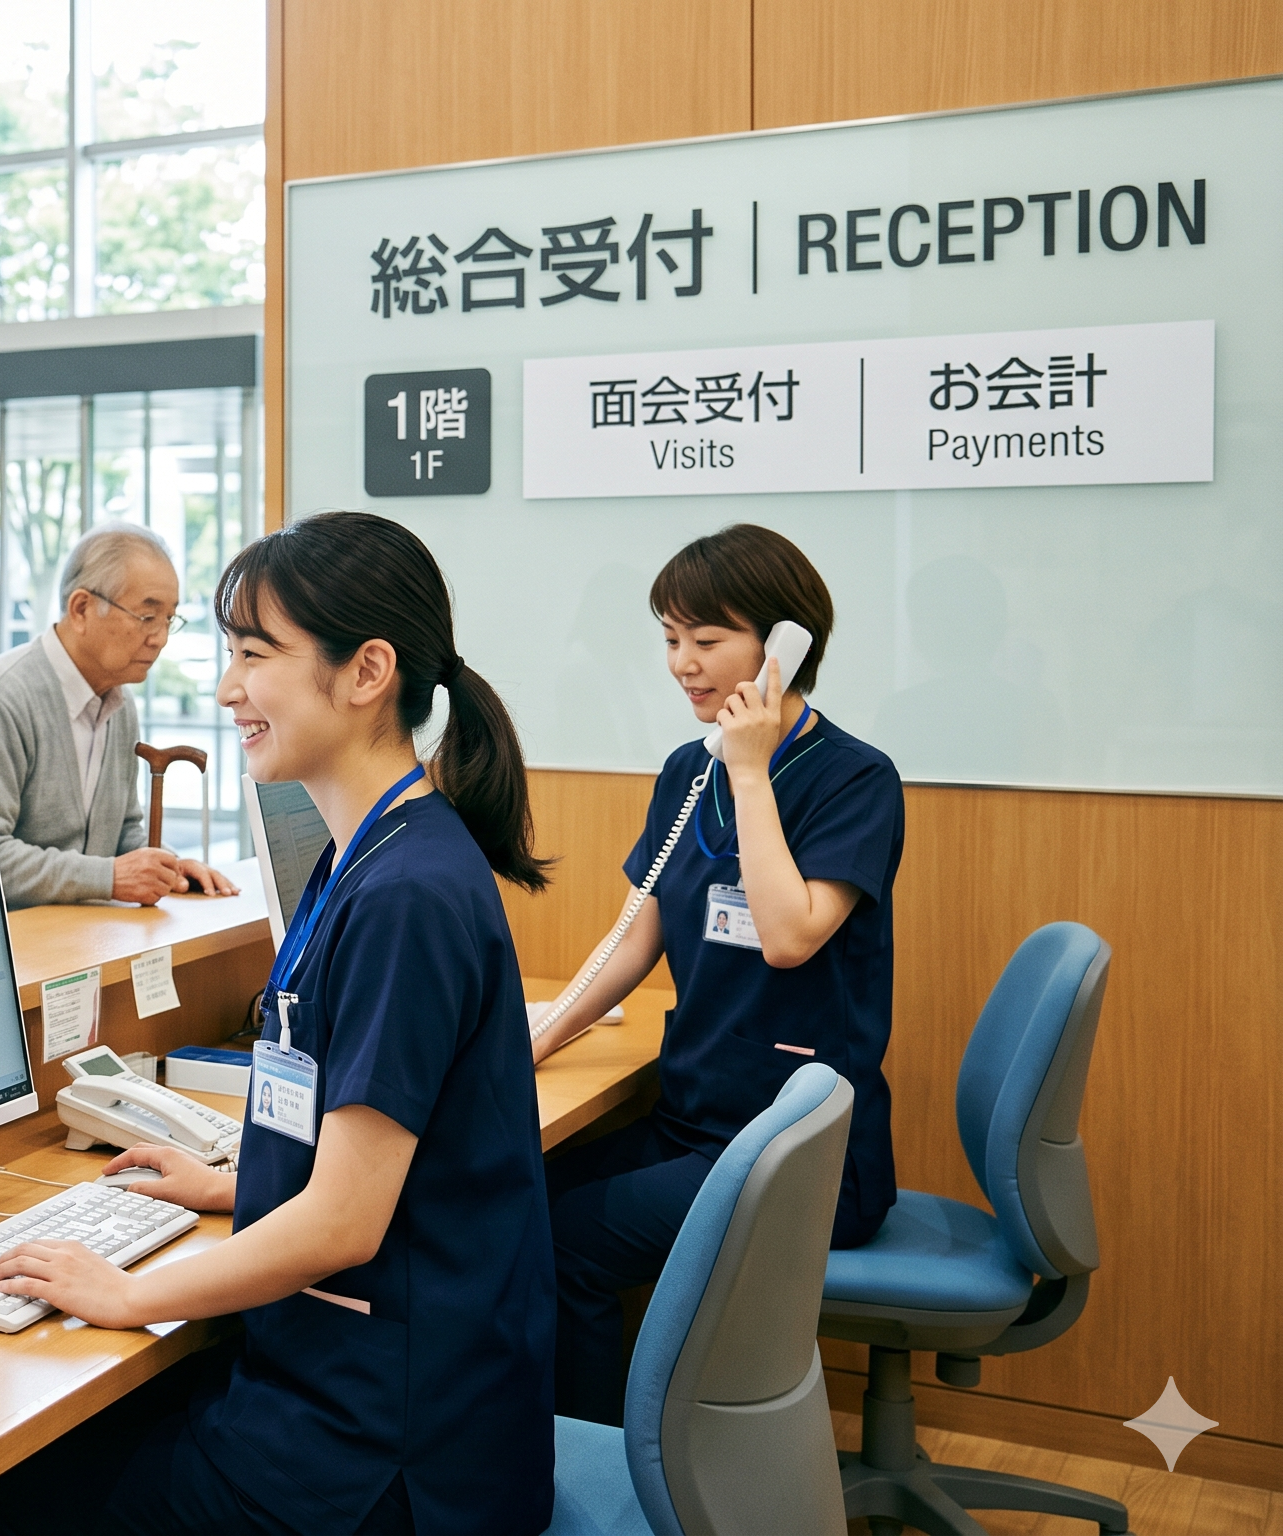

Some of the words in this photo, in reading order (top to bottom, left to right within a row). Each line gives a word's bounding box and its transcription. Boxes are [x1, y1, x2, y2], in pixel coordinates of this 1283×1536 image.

[798, 178, 1207, 275] RECEPTION
[370, 208, 714, 319] 総合受付
[589, 369, 800, 429] 面会受付
[928, 352, 1108, 411] お会計
[387, 387, 469, 441] 1階
[410, 449, 444, 480] 1F
[650, 439, 735, 470] Visits
[928, 424, 1105, 467] Payments
